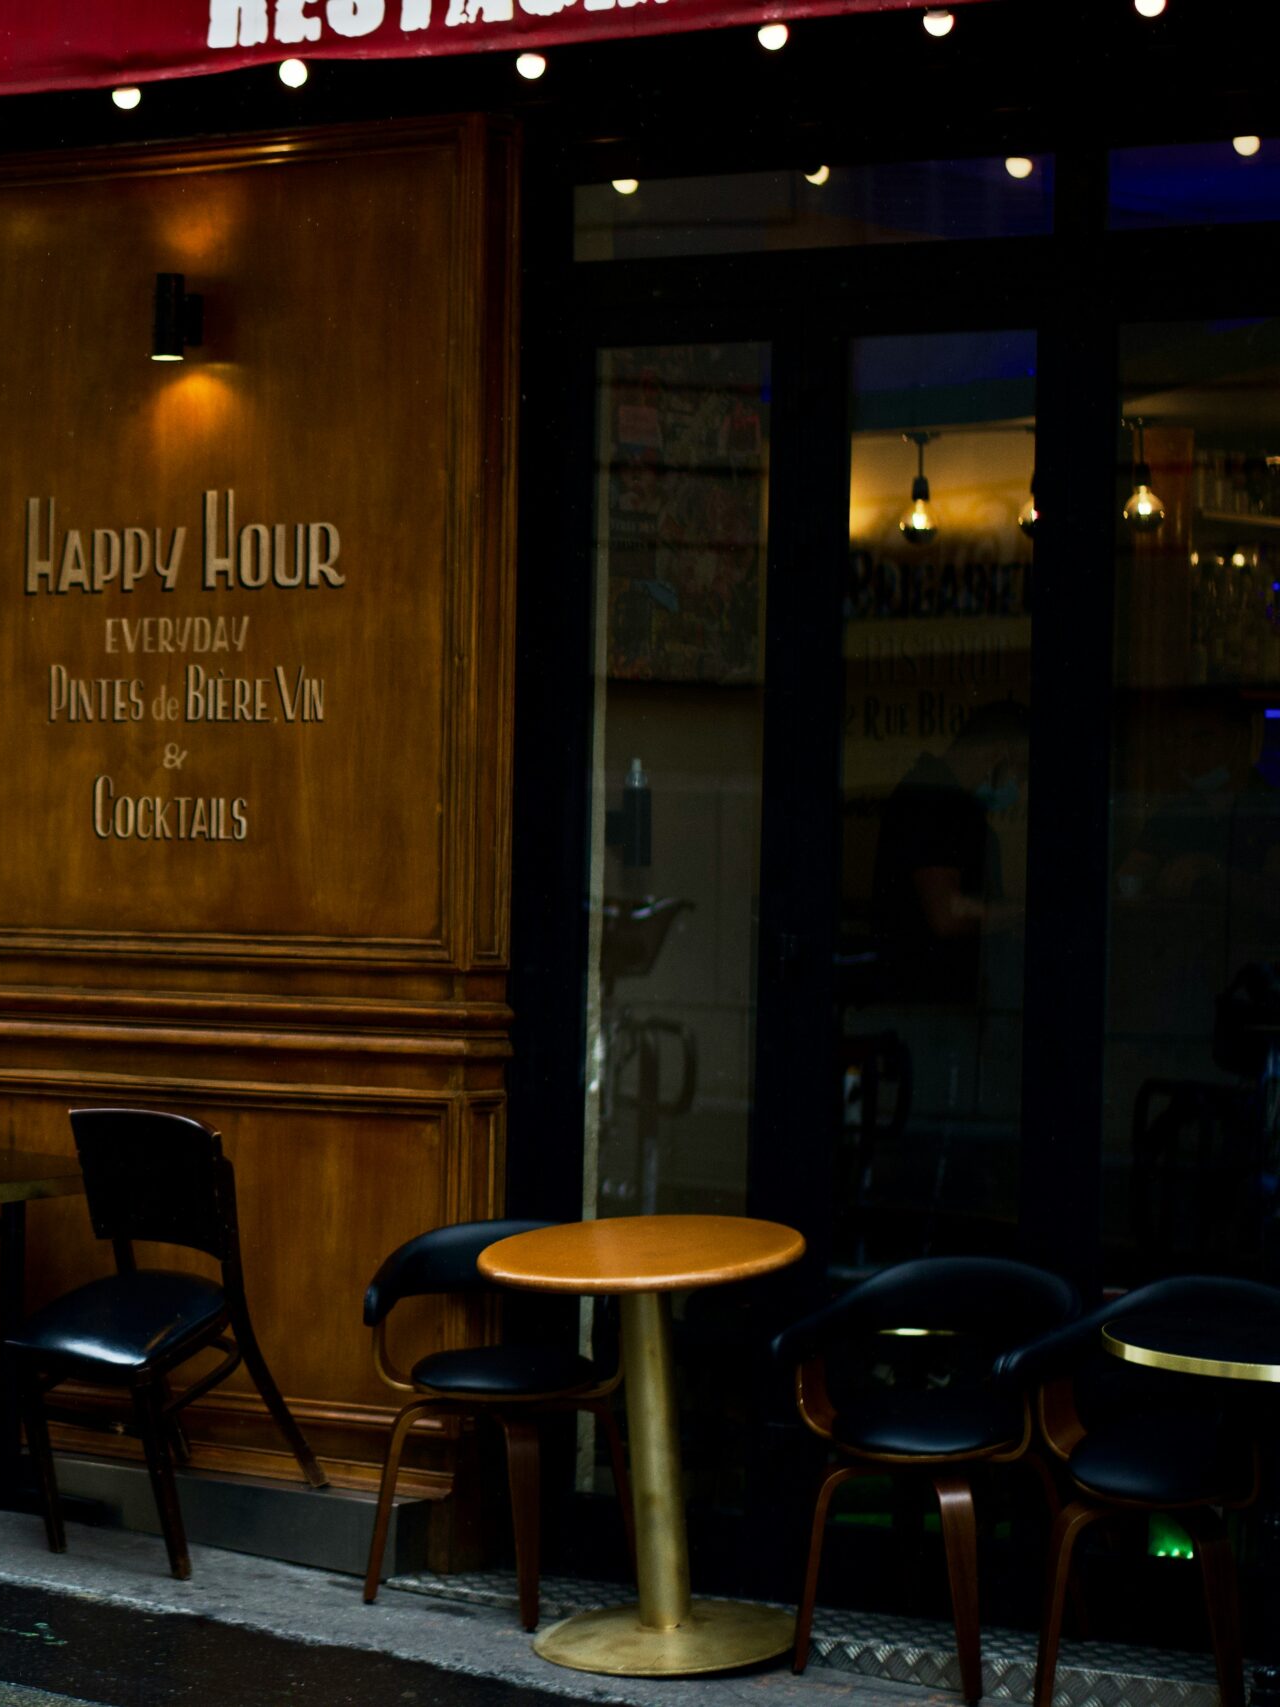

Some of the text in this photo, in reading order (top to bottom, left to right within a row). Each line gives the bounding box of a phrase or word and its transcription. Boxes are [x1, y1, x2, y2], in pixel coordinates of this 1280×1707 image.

[24, 488, 346, 594] HAPPY HOUR
[105, 615, 250, 653] EVERYDAY
[49, 664, 144, 722] PINTES
[151, 684, 179, 722] de
[275, 664, 324, 722] VIN
[163, 743, 187, 770] &
[93, 775, 248, 841] COCKTAILS
